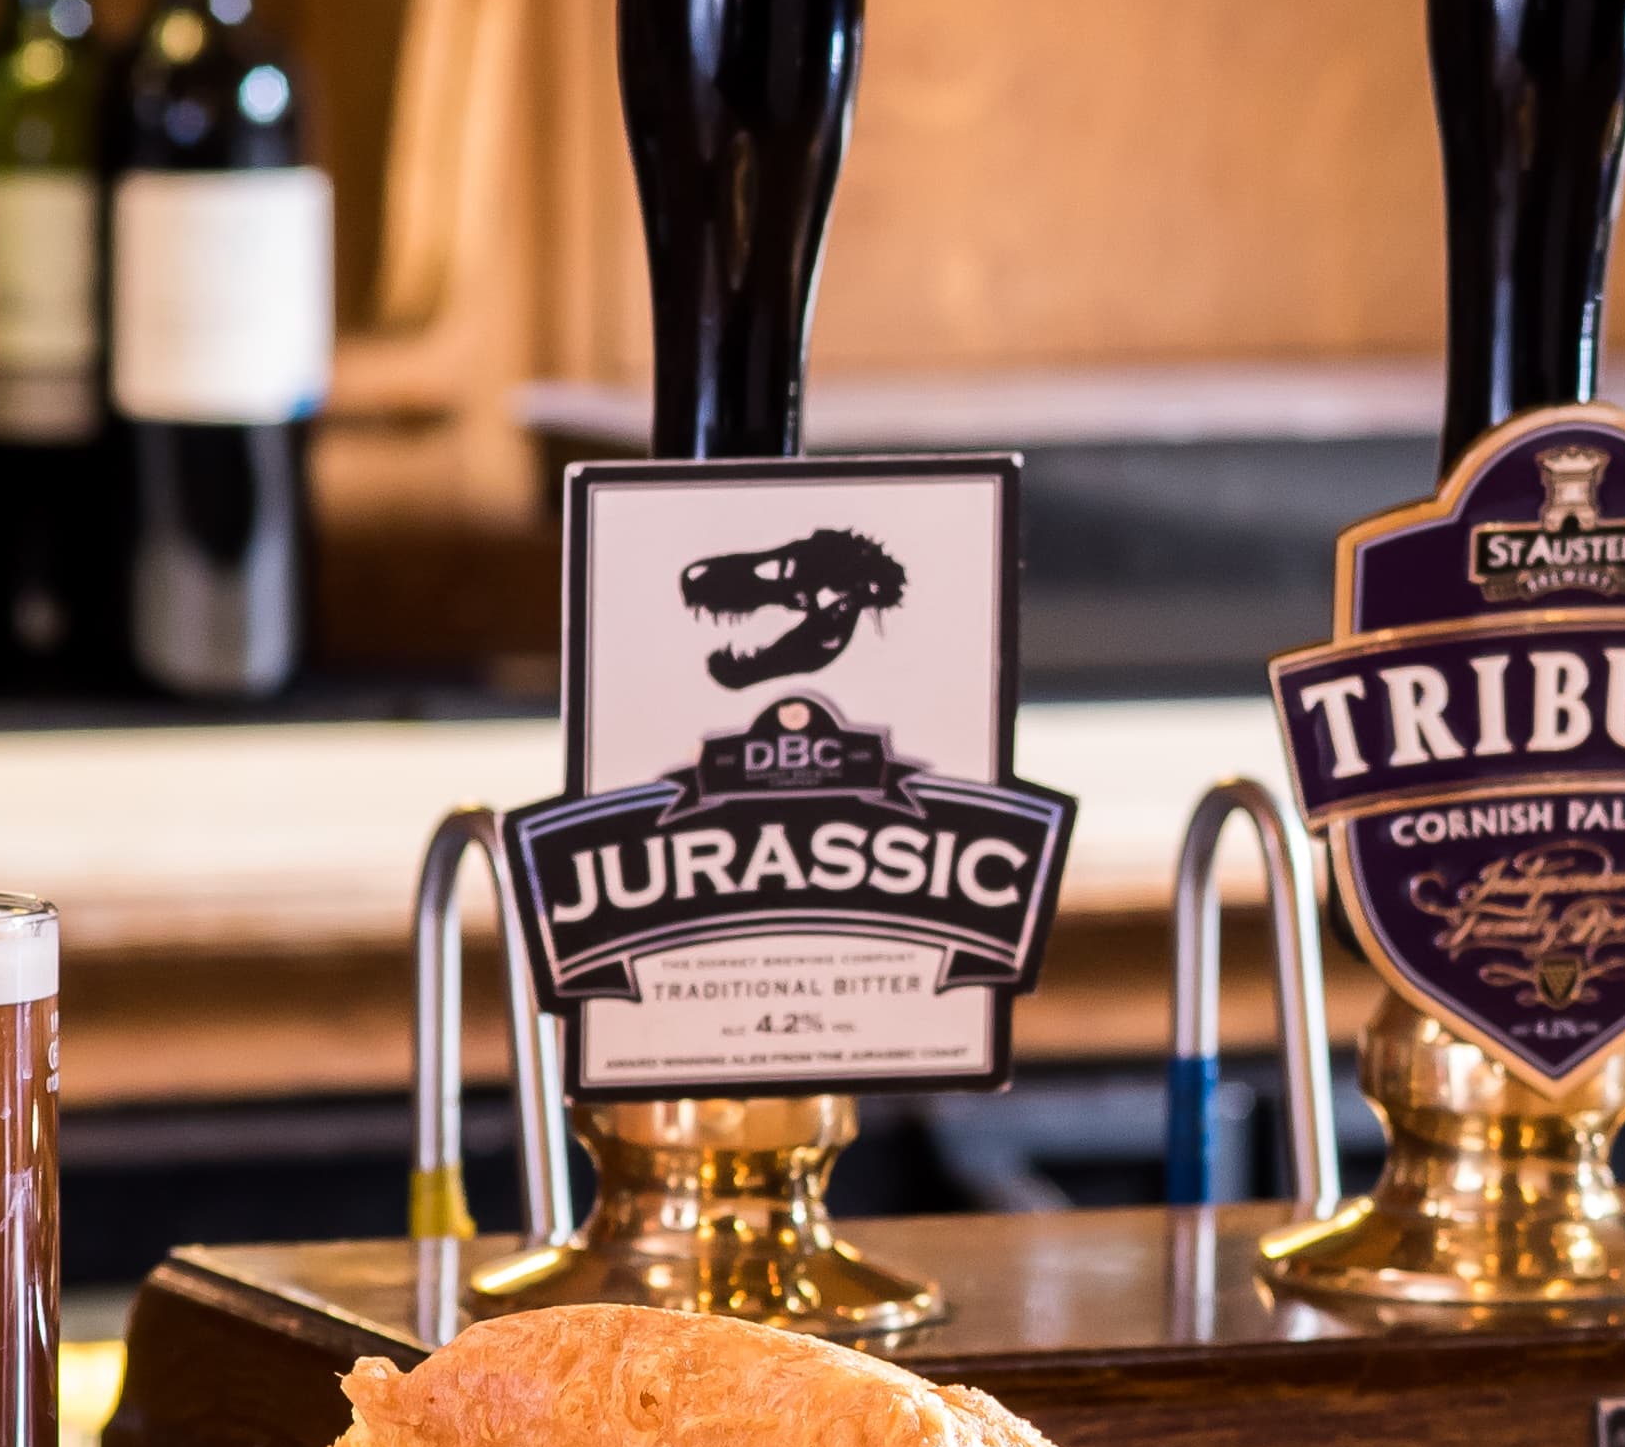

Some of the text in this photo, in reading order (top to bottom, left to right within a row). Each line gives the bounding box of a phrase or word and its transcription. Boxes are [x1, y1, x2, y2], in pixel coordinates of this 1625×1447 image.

[744, 734, 843, 771] DBC
[1389, 800, 1555, 847] CORNISH
[552, 822, 1028, 925] JURASSIC
[653, 975, 922, 1002] TRADITIONAL BITTER
[755, 1012, 824, 1034] 4.2%
